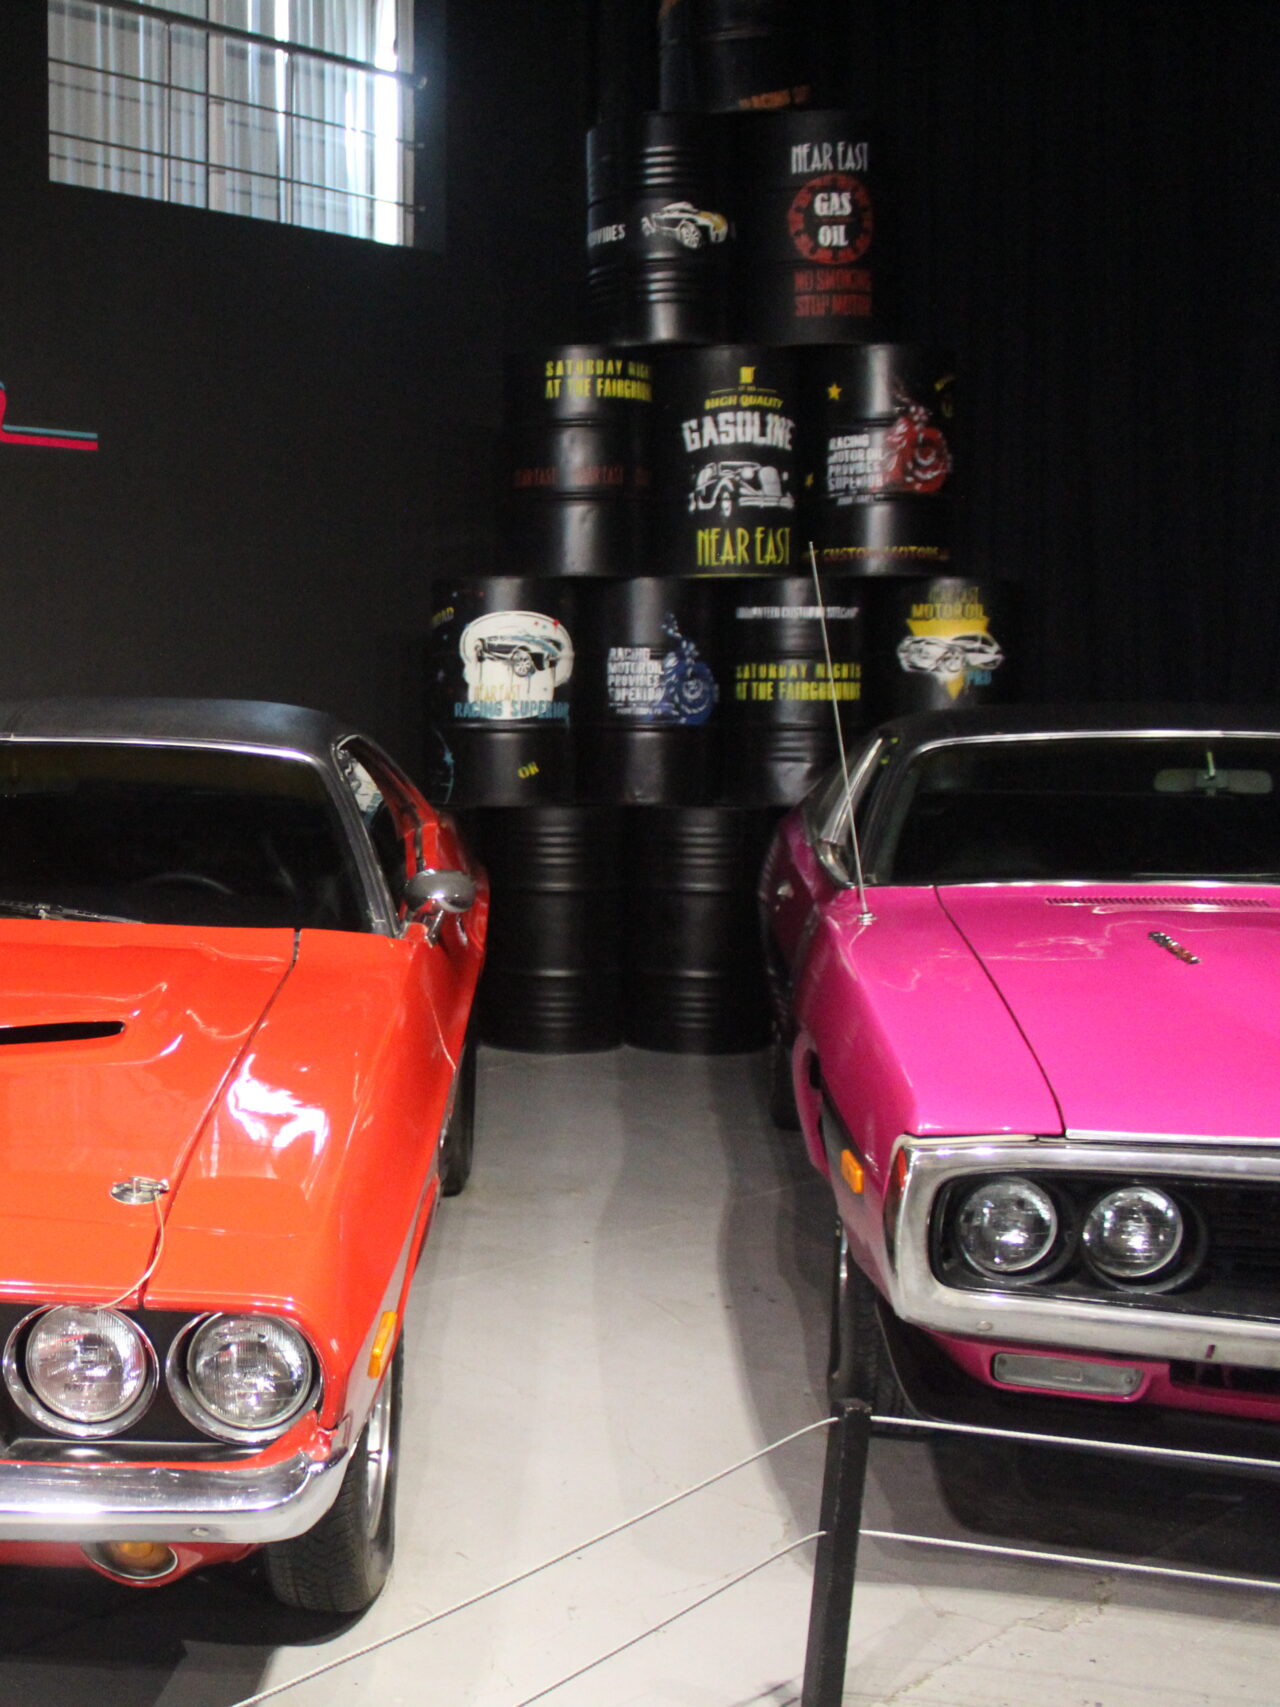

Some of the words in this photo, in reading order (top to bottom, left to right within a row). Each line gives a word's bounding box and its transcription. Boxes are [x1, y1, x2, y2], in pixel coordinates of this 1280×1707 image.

[790, 142, 834, 175] NEAR
[837, 141, 869, 172] EAST
[814, 191, 852, 216] GAS
[818, 224, 849, 248] OIL
[545, 359, 623, 378] SATURDAY
[545, 378, 561, 399] AT
[739, 394, 784, 409] QUALITY
[681, 410, 796, 453] GASOLINE
[696, 527, 751, 567] NEAR
[754, 525, 791, 566] EAST
[911, 602, 963, 620] MOTOR
[736, 662, 808, 679] SATURDAY
[751, 681, 774, 700] THE
[454, 701, 503, 719] RACING
[511, 700, 570, 720] SUPERIOR
